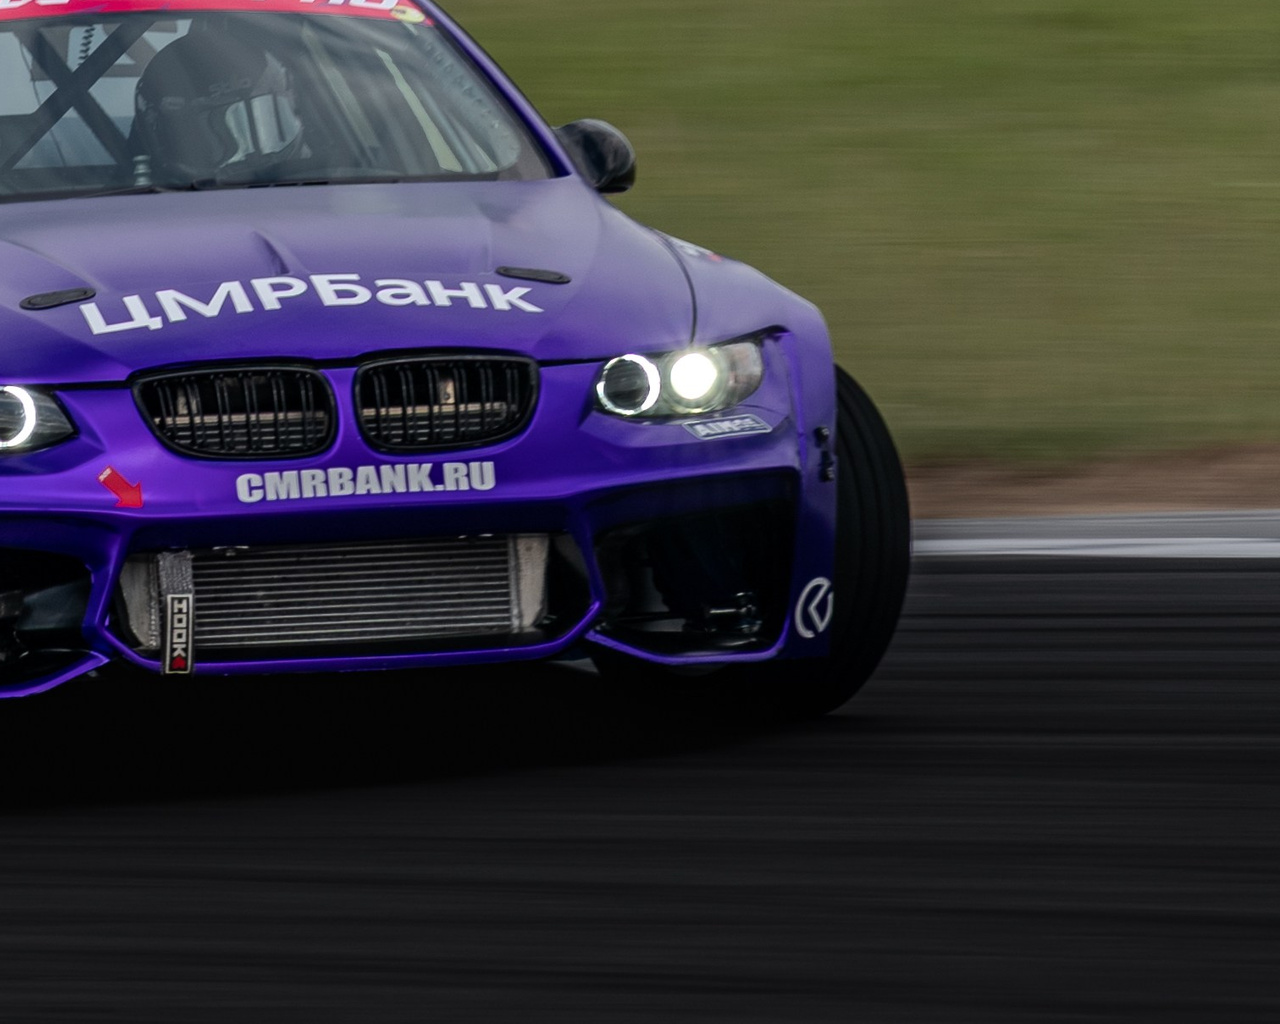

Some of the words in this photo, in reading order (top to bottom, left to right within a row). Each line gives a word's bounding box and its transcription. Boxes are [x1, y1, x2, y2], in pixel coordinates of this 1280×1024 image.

[79, 273, 544, 335] ЦМРБанк
[236, 461, 496, 503] CMRBANK.RU
[172, 599, 188, 657] HOOK
